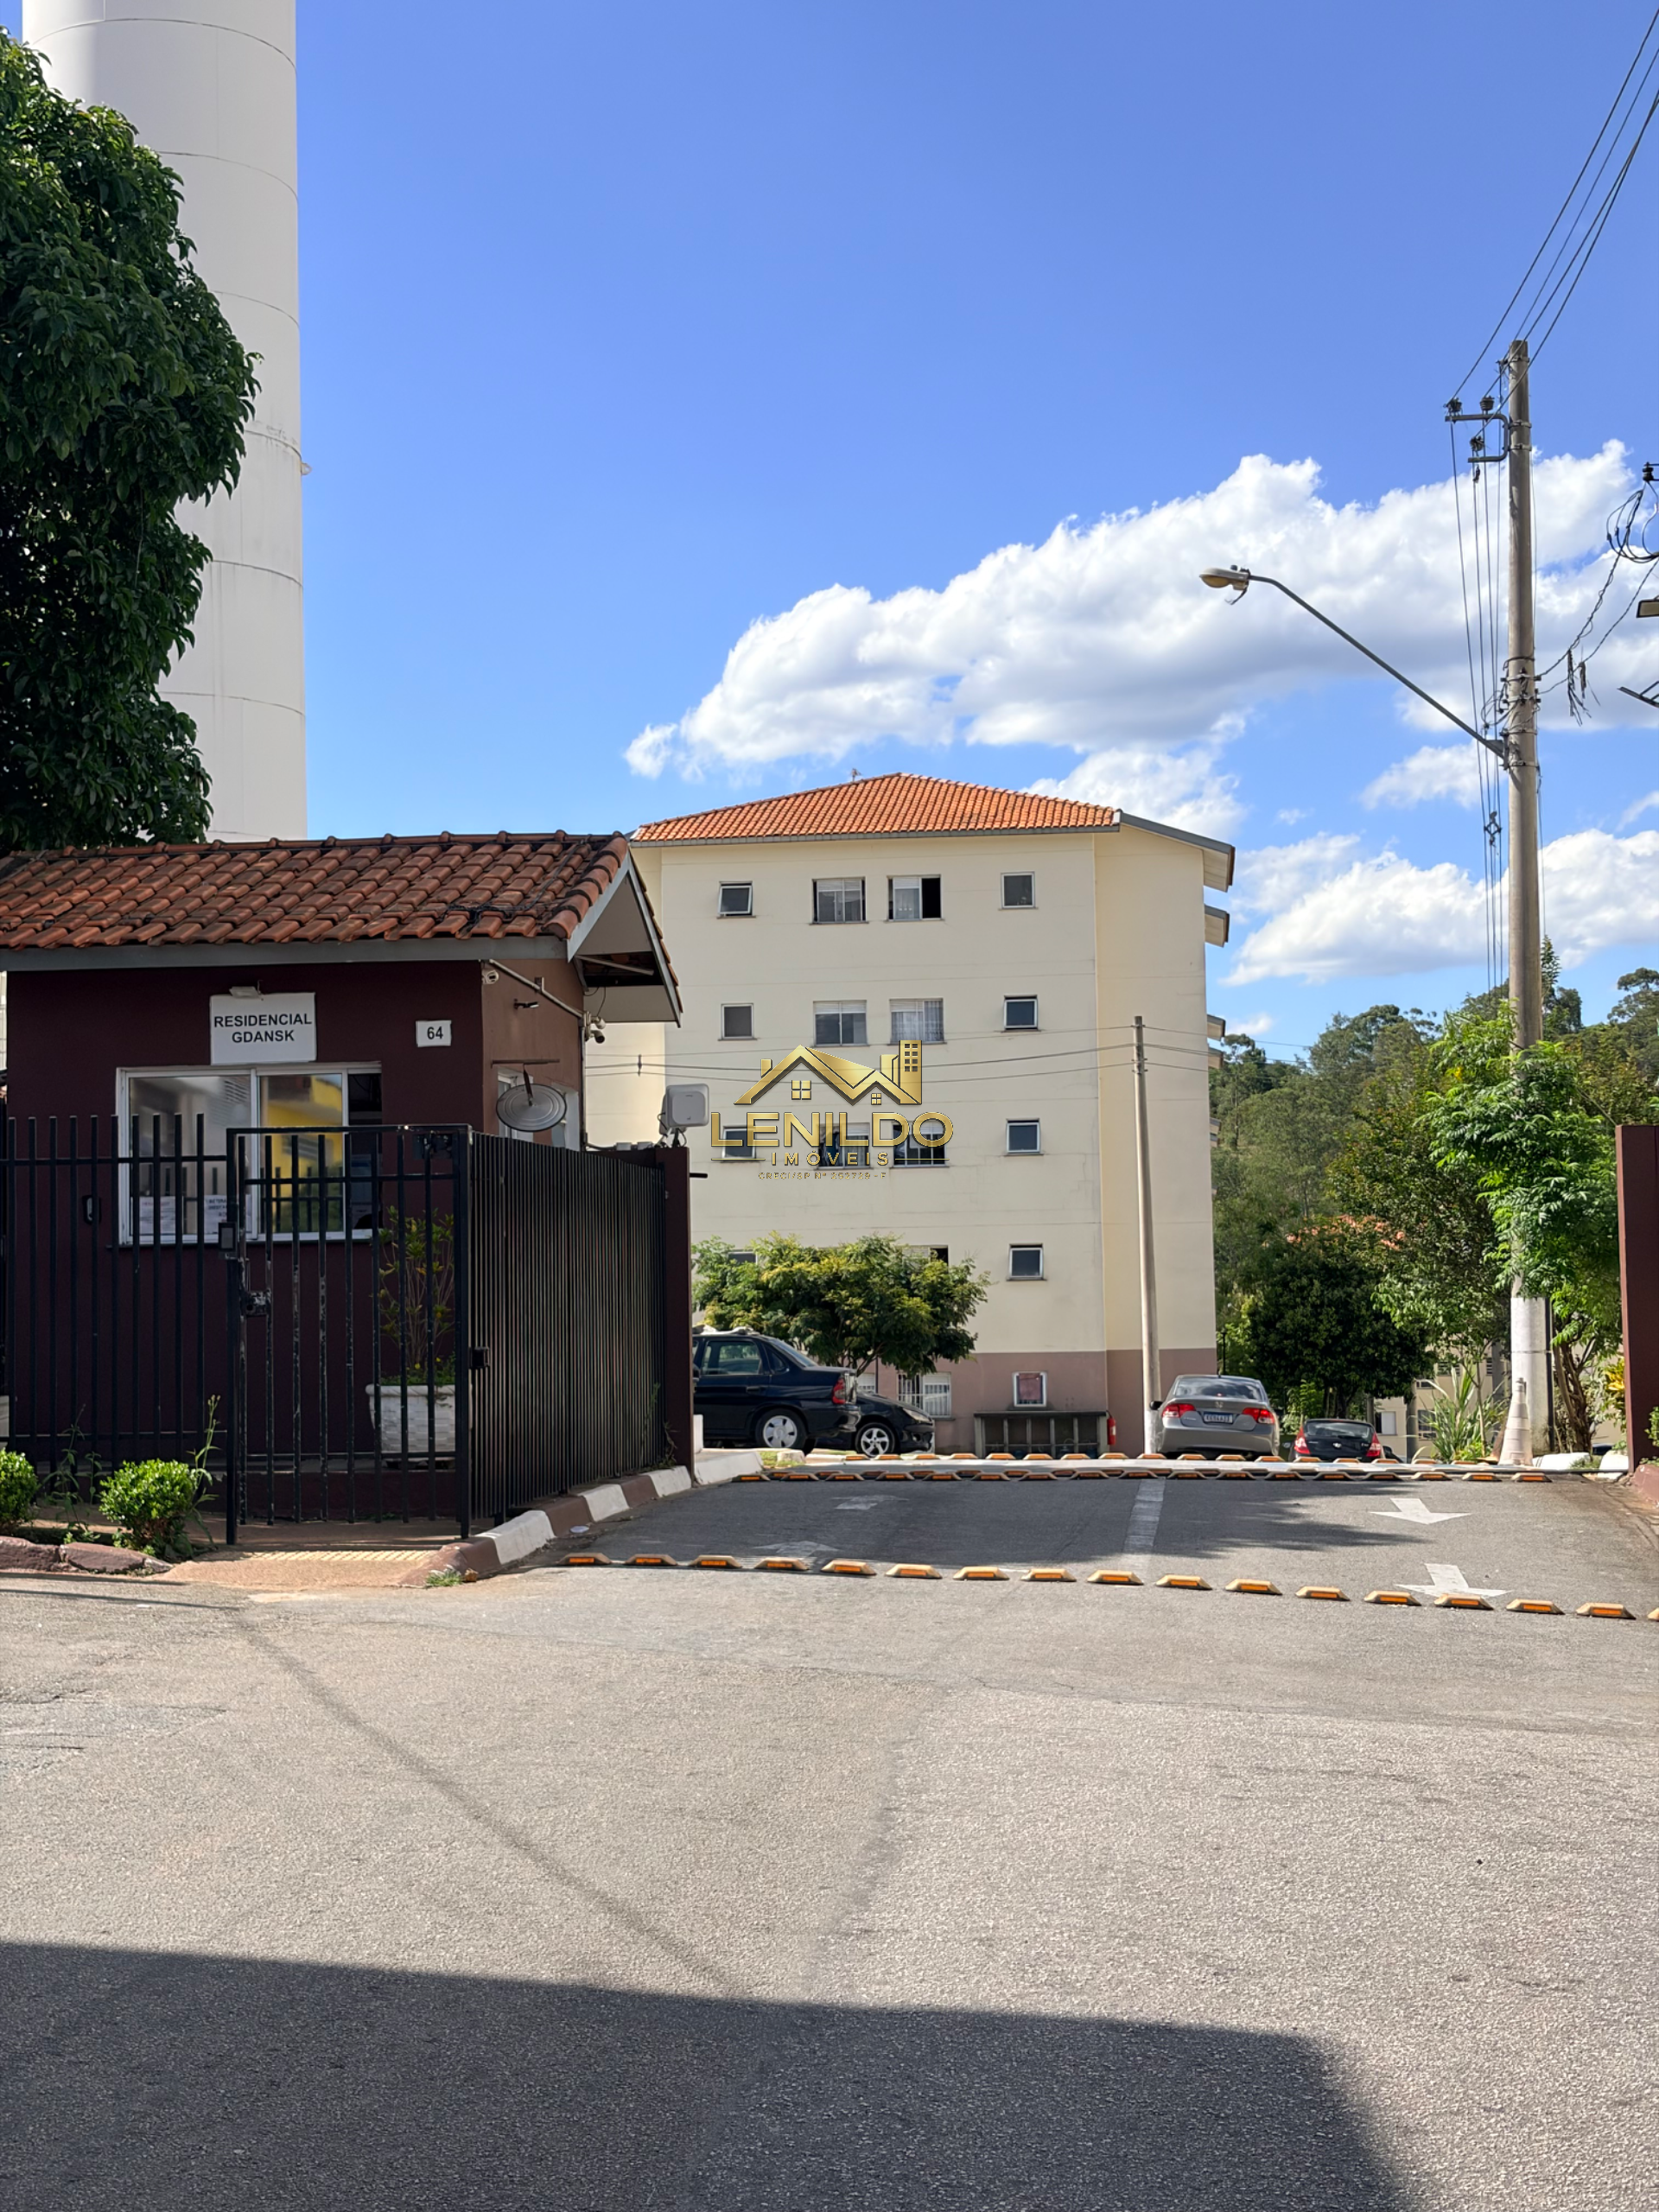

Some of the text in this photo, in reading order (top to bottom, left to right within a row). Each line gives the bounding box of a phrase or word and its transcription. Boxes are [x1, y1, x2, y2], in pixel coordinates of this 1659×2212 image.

[213, 1013, 313, 1028] RESIDENCIAL
[232, 1029, 295, 1044] GDANSK
[427, 1027, 443, 1039] 64
